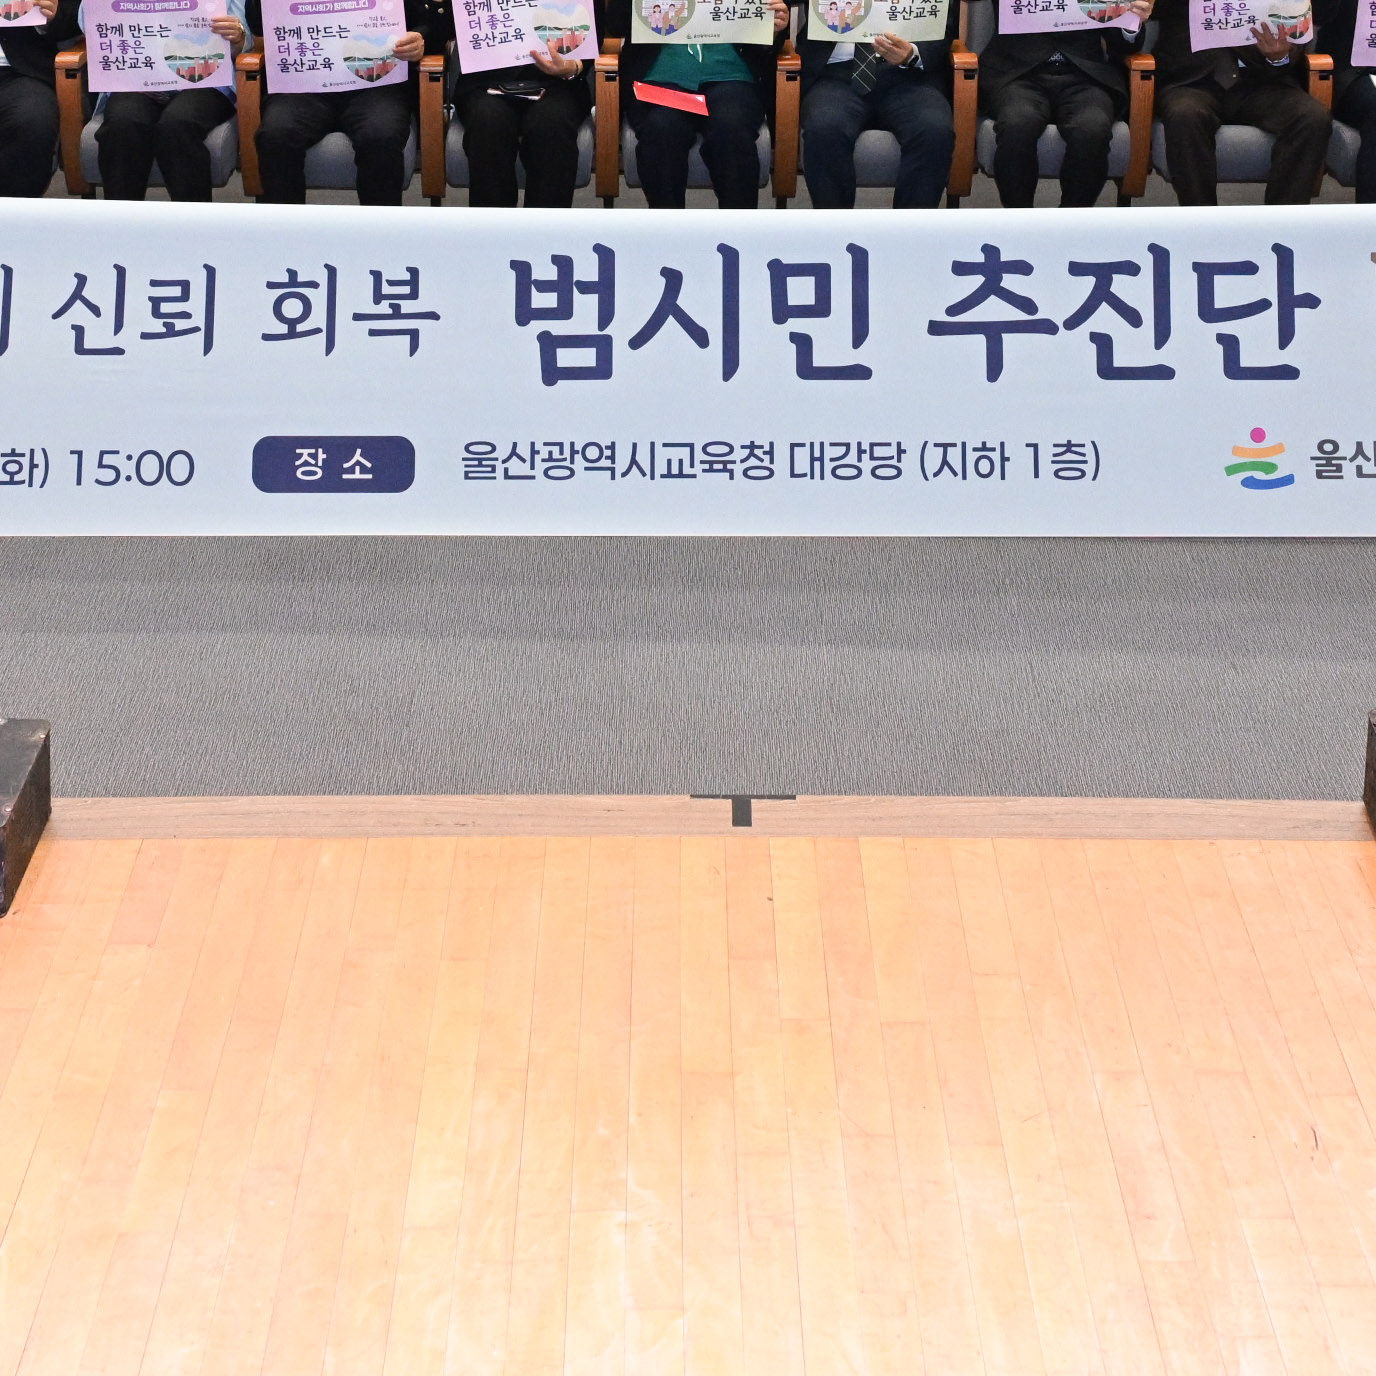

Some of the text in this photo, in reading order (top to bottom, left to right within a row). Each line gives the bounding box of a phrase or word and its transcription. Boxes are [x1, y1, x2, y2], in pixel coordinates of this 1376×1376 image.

[119, 0, 190, 11] 지역사회가 함께합니다
[709, 5, 766, 21] 울산교육
[95, 22, 171, 39] 함께 만드는
[99, 38, 145, 55] 더 좋은
[98, 54, 155, 71] 울산교육
[51, 263, 217, 357] 신뢰
[260, 262, 441, 358] 회복
[509, 242, 873, 387] 범시민
[926, 242, 1322, 384] 추진단
[69, 449, 195, 487] 15:00
[461, 439, 1100, 482] 울산광역시교육청 대강당 (지하 1층)
